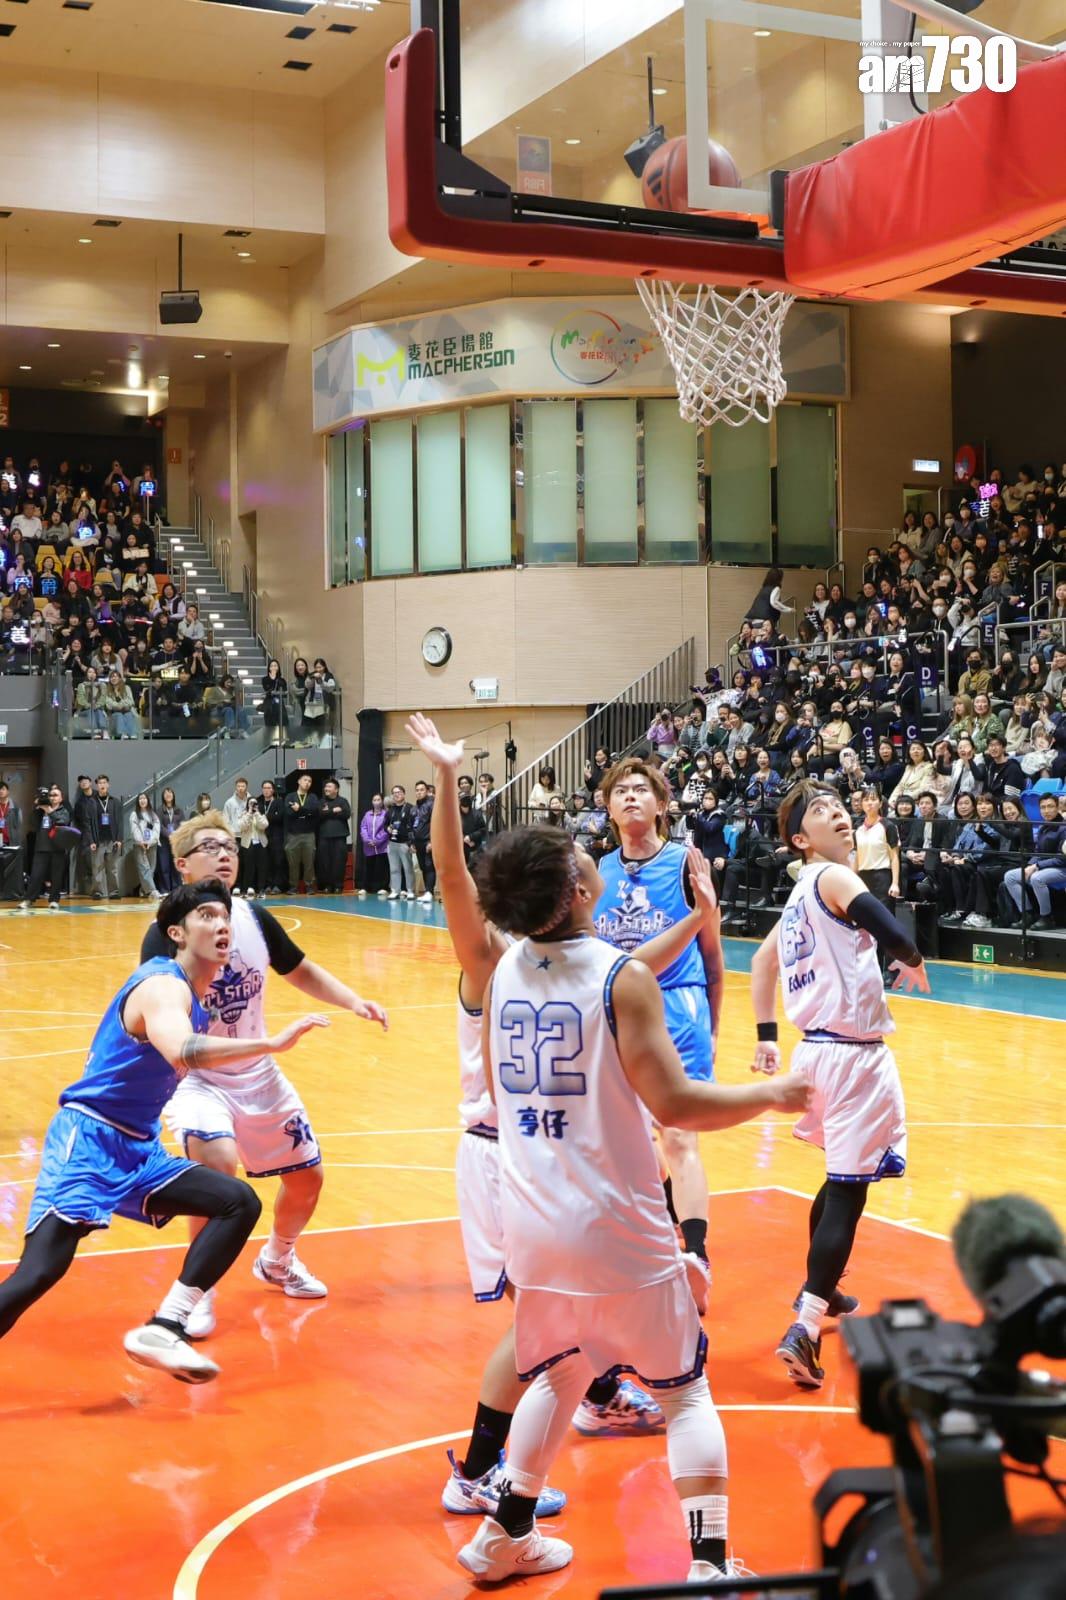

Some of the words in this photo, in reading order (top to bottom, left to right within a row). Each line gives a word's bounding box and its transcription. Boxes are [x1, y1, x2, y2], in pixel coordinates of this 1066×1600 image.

[408, 349, 515, 380] MACPHERSON
[985, 625, 993, 637] E
[921, 667, 931, 680] D
[862, 727, 873, 740] C
[906, 726, 917, 739] C
[224, 970, 262, 1002] STAR
[499, 1000, 587, 1096] 32
